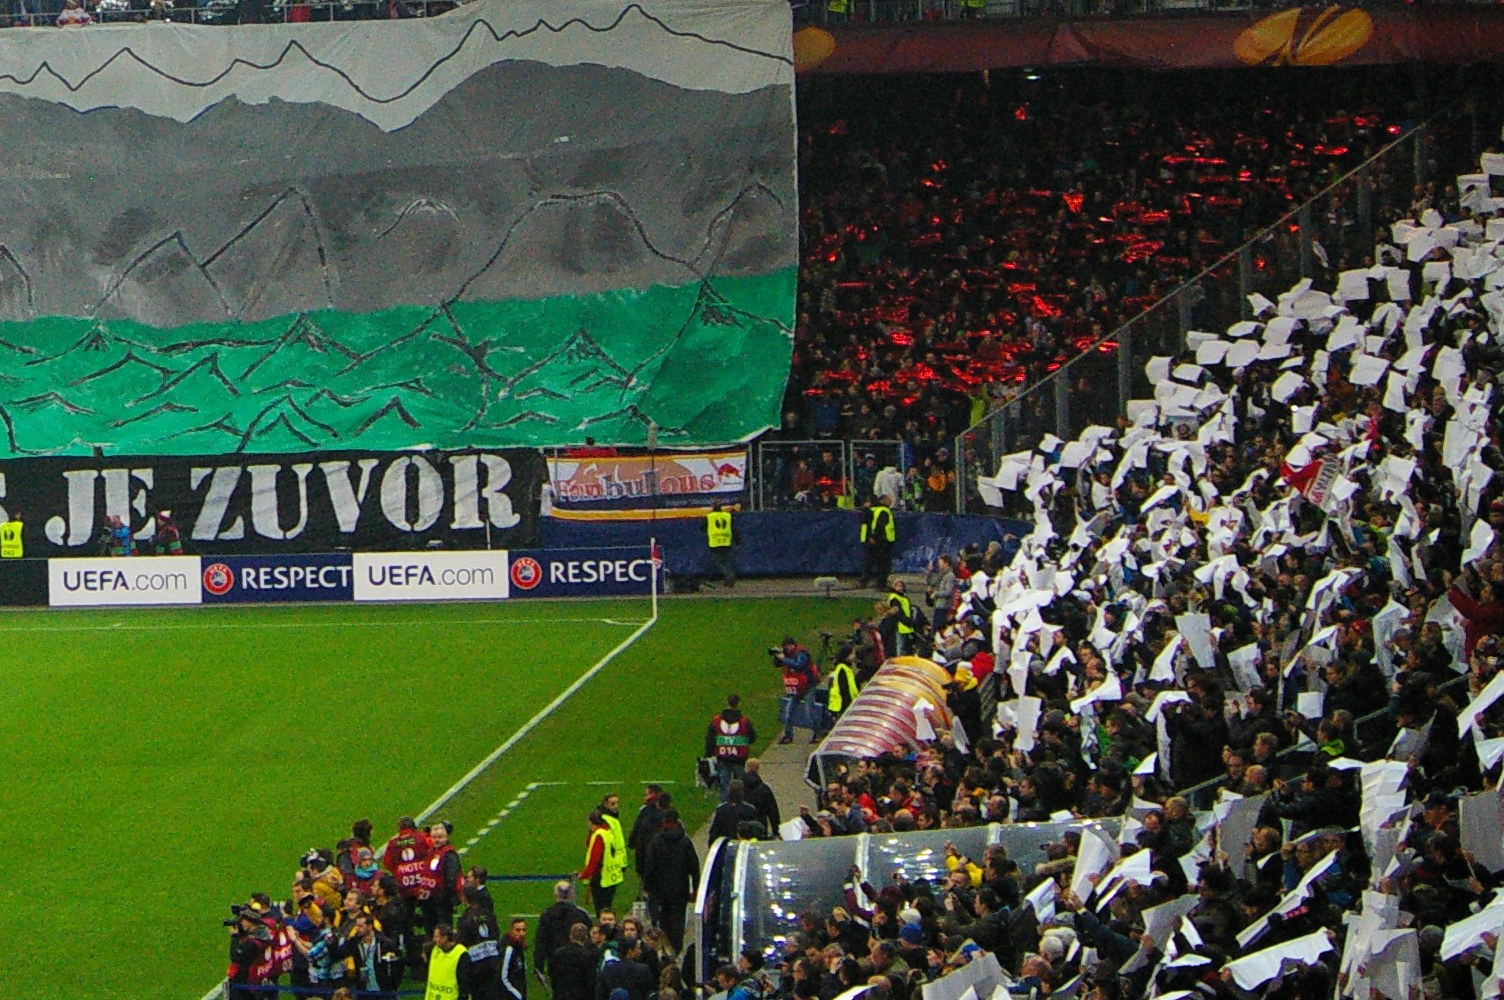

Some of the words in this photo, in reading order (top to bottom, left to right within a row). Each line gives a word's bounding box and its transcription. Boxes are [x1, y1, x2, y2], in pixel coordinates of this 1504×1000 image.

[45, 468, 157, 546] JE
[190, 454, 520, 540] ZUVOR
[63, 570, 187, 591] UEFA.com
[241, 566, 352, 589] RESPECT
[368, 563, 494, 586] UEFA.com
